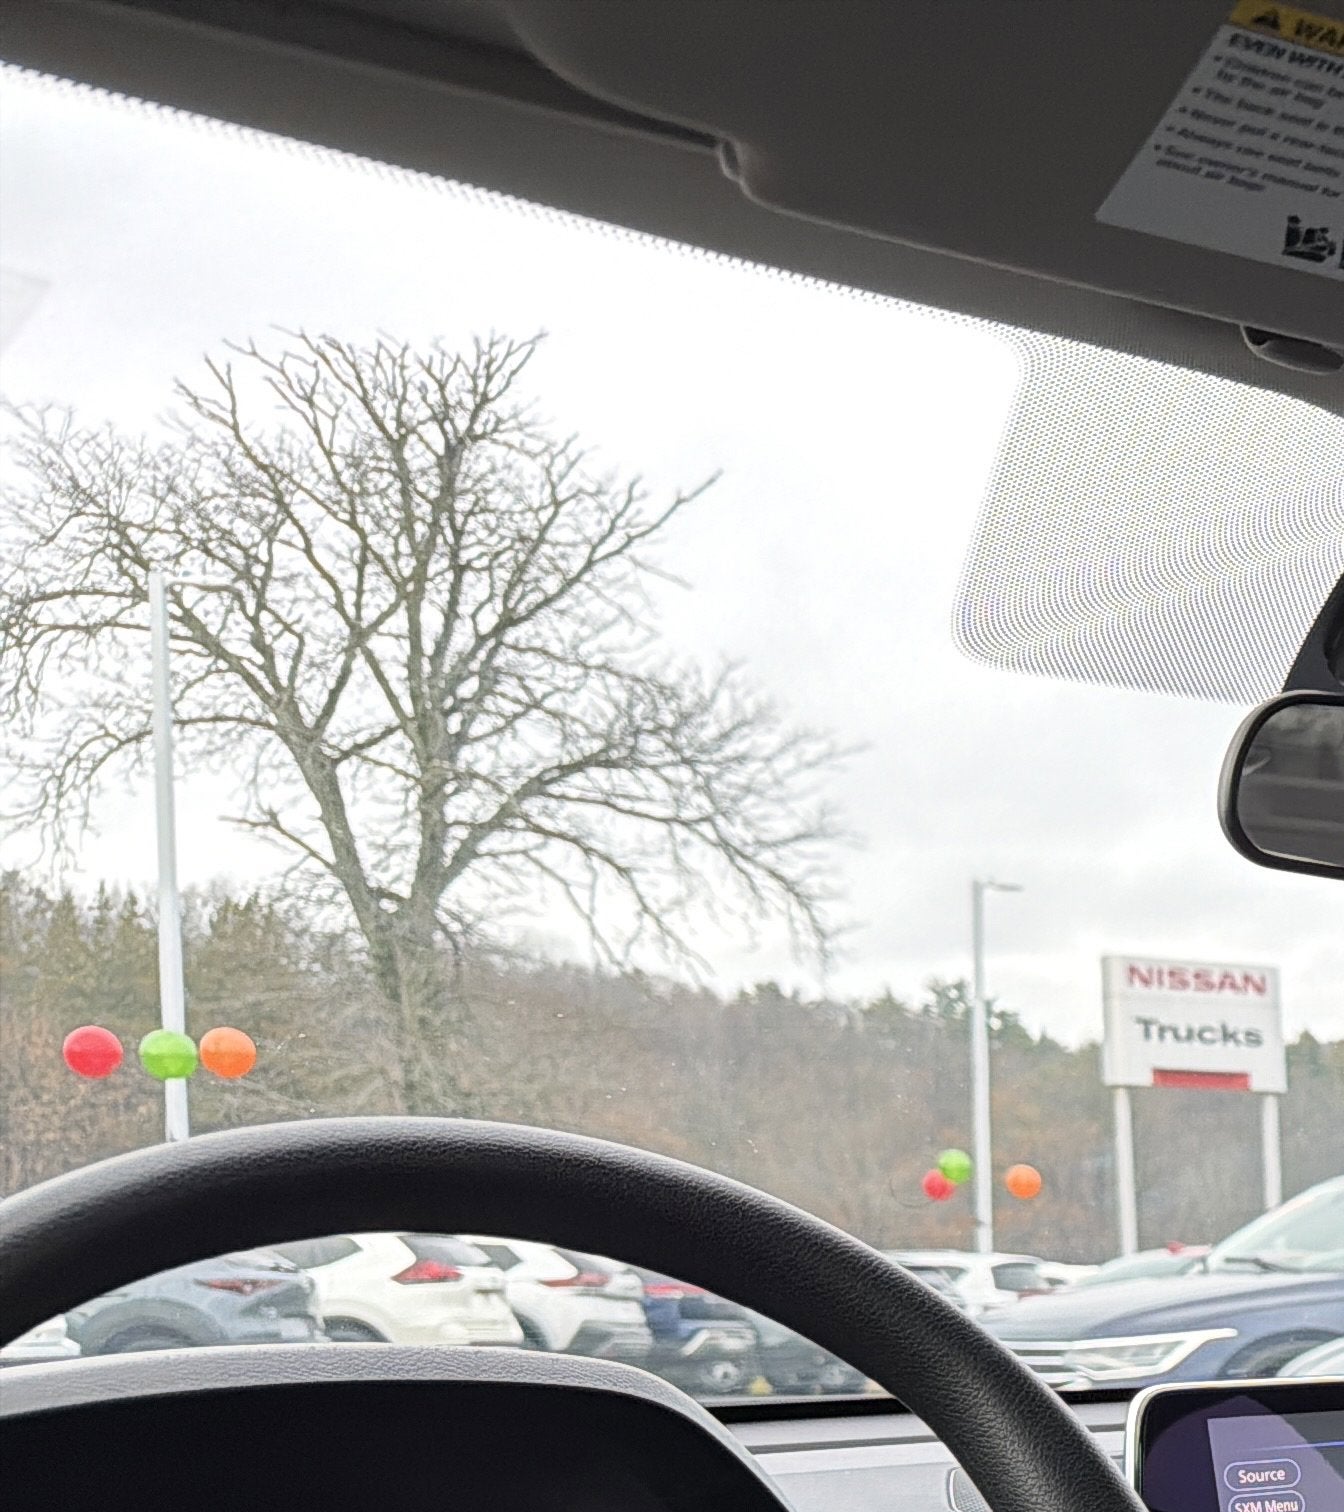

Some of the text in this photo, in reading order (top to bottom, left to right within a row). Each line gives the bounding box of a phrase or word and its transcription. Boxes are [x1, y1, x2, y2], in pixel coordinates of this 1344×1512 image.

[1286, 49, 1344, 76] WITH
[1126, 963, 1267, 996] NISSAN
[1134, 1014, 1264, 1048] Trucks
[1237, 1468, 1286, 1484] Source
